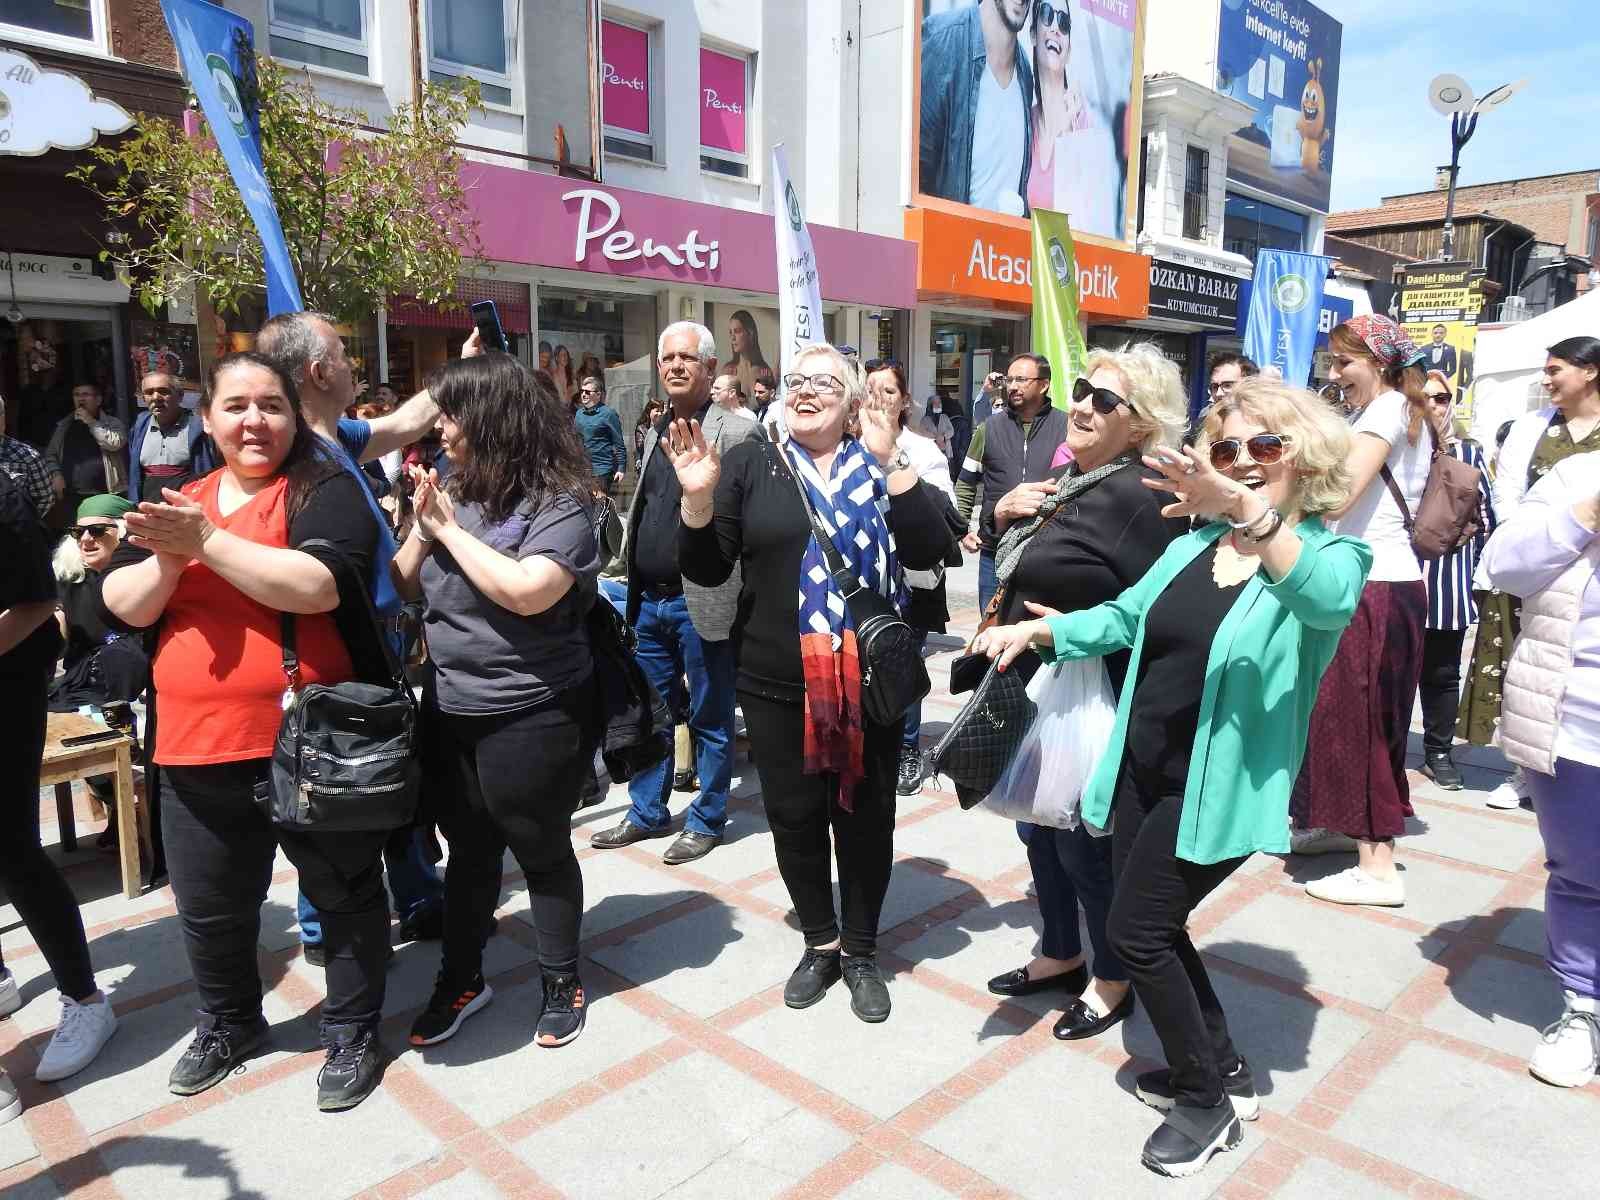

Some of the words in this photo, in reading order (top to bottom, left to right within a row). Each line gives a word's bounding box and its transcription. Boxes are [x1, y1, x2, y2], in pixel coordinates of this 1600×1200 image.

[1245, 9, 1281, 46] internet
[1282, 31, 1307, 61] keyfi!
[1289, 15, 1310, 37] evde
[602, 63, 644, 91] Penti
[704, 88, 742, 114] Penti
[561, 189, 719, 270] Penti
[1074, 260, 1120, 303] ptik
[1150, 260, 1196, 294] ÖZKAN
[1198, 276, 1239, 300] BARAZ
[1407, 274, 1437, 285] Daniel
[1438, 271, 1467, 284] Rossi
[1167, 298, 1218, 317] KUYUMCULUK
